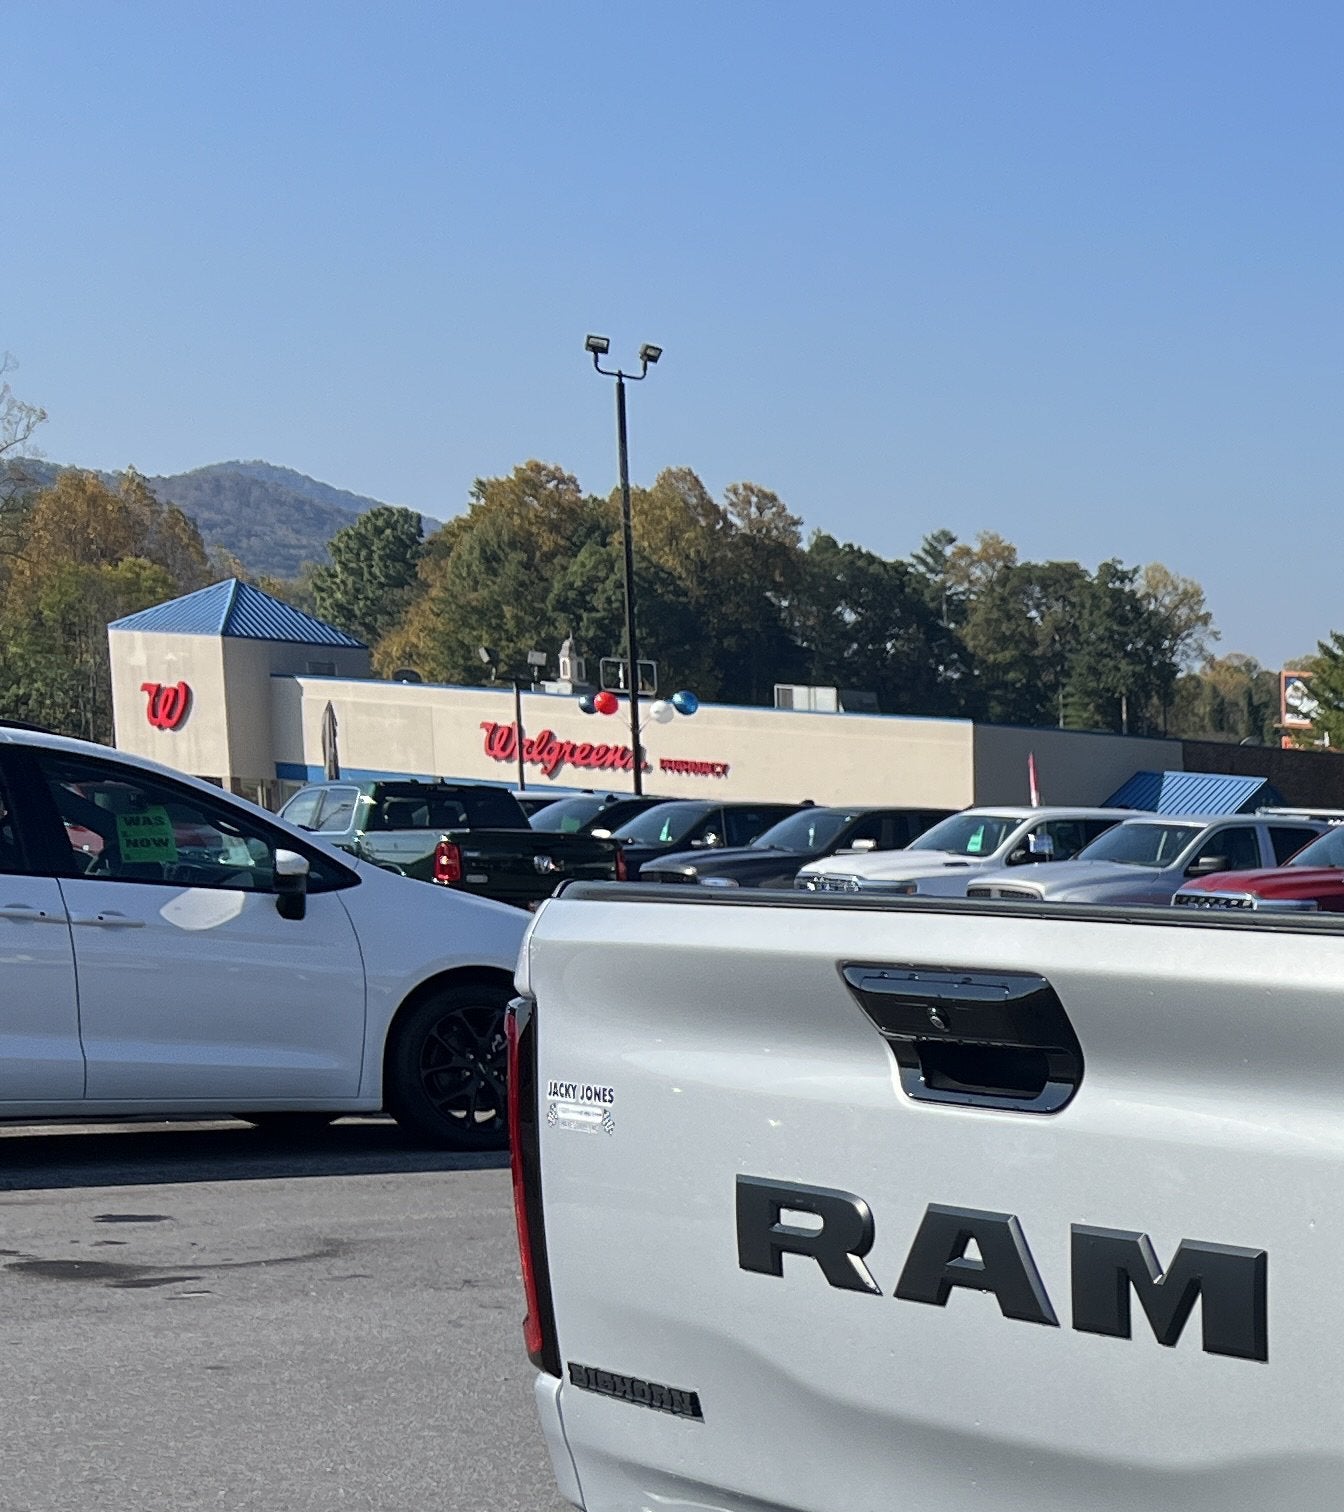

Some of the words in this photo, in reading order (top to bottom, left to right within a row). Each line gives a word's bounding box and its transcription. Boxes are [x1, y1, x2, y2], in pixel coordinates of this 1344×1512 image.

[125, 838, 169, 848] NOW
[548, 1081, 577, 1099] JACKY
[580, 1085, 614, 1104] JONES
[736, 1174, 1268, 1363] RAM
